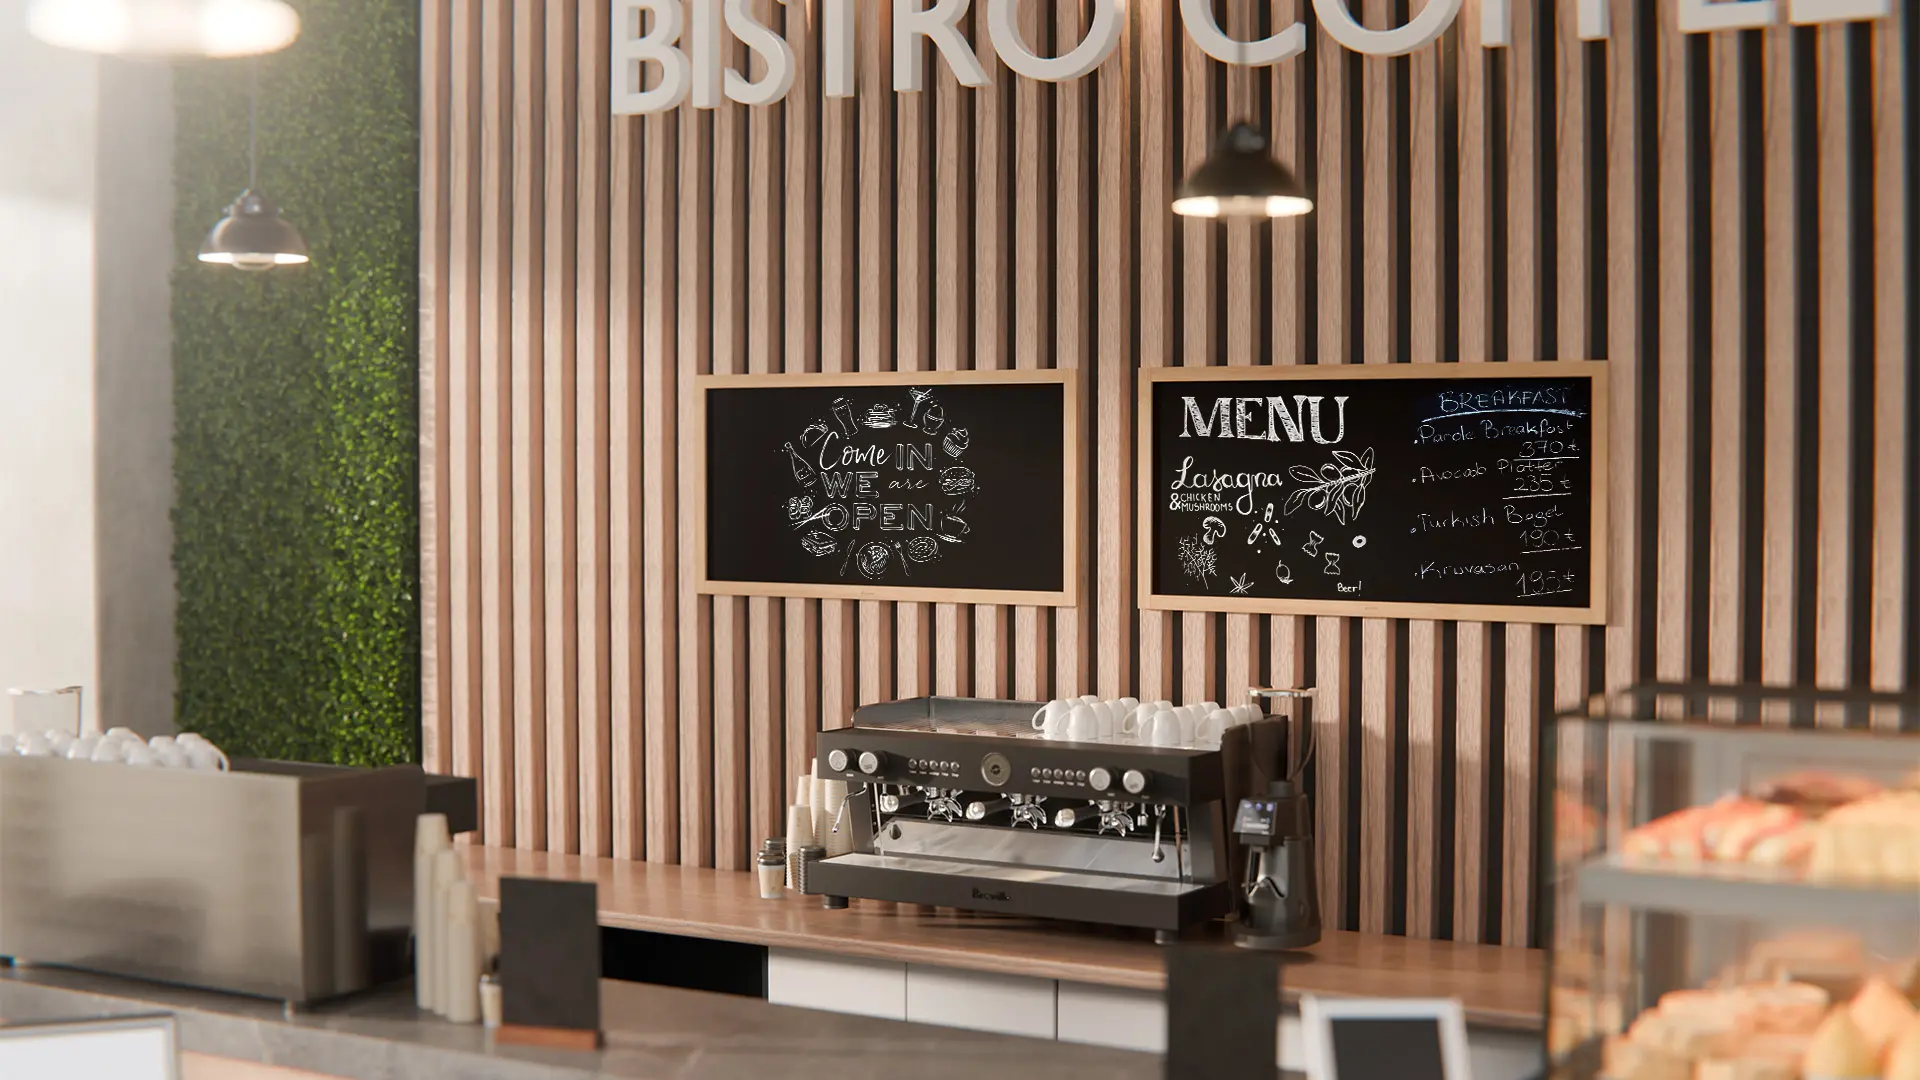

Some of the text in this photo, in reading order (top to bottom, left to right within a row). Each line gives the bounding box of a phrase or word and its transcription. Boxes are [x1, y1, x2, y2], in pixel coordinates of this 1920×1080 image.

[1439, 385, 1573, 412] BREAKFAST
[1179, 395, 1349, 444] MENU
[819, 431, 933, 471] Come IN
[1519, 440, 1564, 458] 370
[820, 471, 930, 499] WE are
[1171, 456, 1283, 515] Lasagna
[1513, 474, 1554, 492] 235
[1181, 492, 1221, 502] CHICKEN
[1181, 502, 1233, 512] MUSHROOMS
[821, 502, 934, 531] OPEN
[1417, 507, 1495, 532] Turkish
[1337, 580, 1362, 597] Beer!
